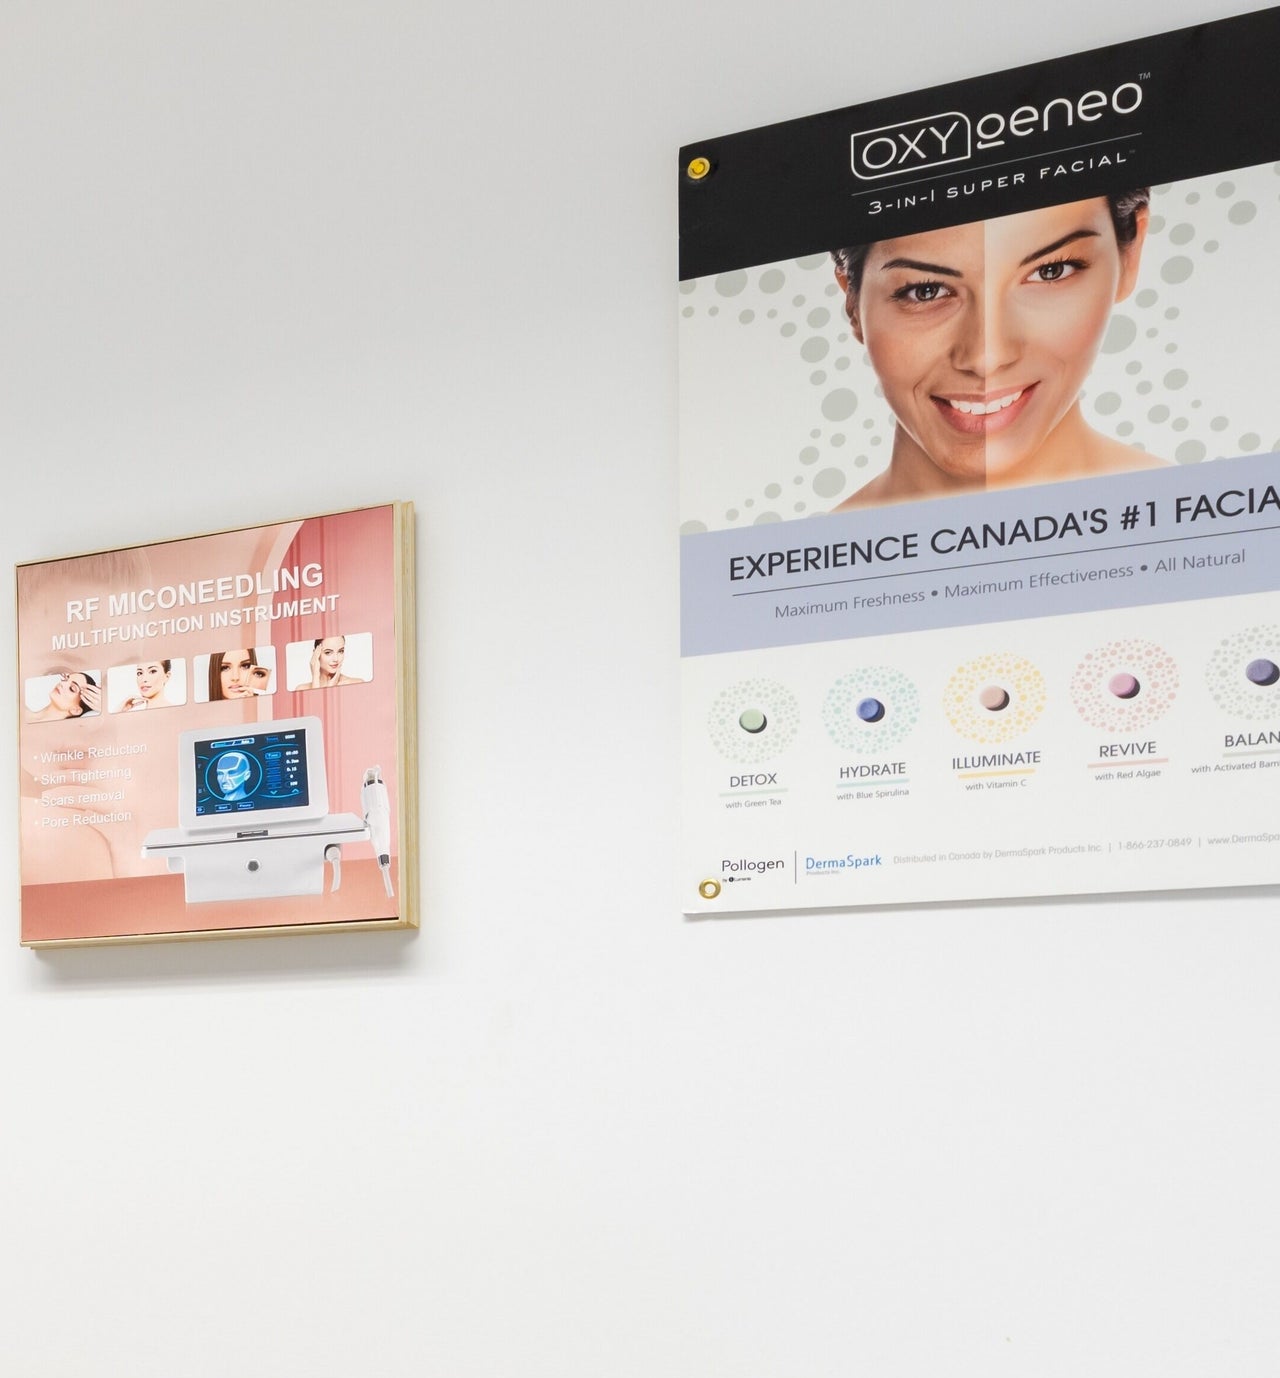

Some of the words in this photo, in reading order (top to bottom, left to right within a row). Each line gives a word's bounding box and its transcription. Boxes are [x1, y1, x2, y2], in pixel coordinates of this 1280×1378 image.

[947, 173, 1026, 199] SUPER
[1040, 152, 1127, 179] FACIAL
[730, 533, 918, 581] EXPERIENCE
[931, 508, 1108, 554] CANADA'S
[1120, 501, 1156, 530] #1
[775, 598, 848, 618] Maximum
[853, 590, 925, 610] Freshness
[945, 578, 1023, 598] Maximum
[1030, 565, 1134, 588] Effectiveness
[1154, 557, 1176, 573] All
[1183, 548, 1245, 570] Natural
[66, 595, 100, 623] RF
[108, 562, 324, 617] MICONEEDLING
[51, 614, 204, 652] MULTIFUNCTION
[209, 593, 341, 630] INSTRUMENT
[40, 749, 84, 763] Wrinkle
[88, 743, 147, 759] Reduction
[1099, 741, 1157, 758] REVIVE
[952, 751, 1041, 770] ILLUMINATE
[1191, 763, 1211, 773] with
[1214, 761, 1256, 772] Activated
[41, 774, 66, 785] Skin
[70, 767, 132, 784] Tightening
[840, 762, 906, 779] HYDRATE
[1095, 771, 1114, 781] with
[1117, 770, 1134, 779] Red
[1136, 769, 1161, 780] Algae
[730, 773, 777, 788] DETOX
[965, 781, 984, 791] with
[986, 780, 1017, 790] Vitamin
[1020, 779, 1028, 787] C
[41, 795, 74, 807] Scars
[78, 788, 125, 803] removal
[837, 792, 854, 801] with
[856, 790, 873, 799] Blue
[876, 788, 910, 799] Spirulina
[726, 801, 742, 809] with
[744, 799, 767, 808] Green
[770, 798, 782, 806] Tea
[41, 817, 69, 828] Pore
[73, 811, 132, 826] Reduction
[806, 854, 882, 871] DermaSpark
[893, 854, 937, 864] Distributed
[948, 851, 980, 861] Canada
[983, 852, 992, 860] by
[1049, 845, 1085, 855] Products
[722, 859, 785, 873] Pollogen
